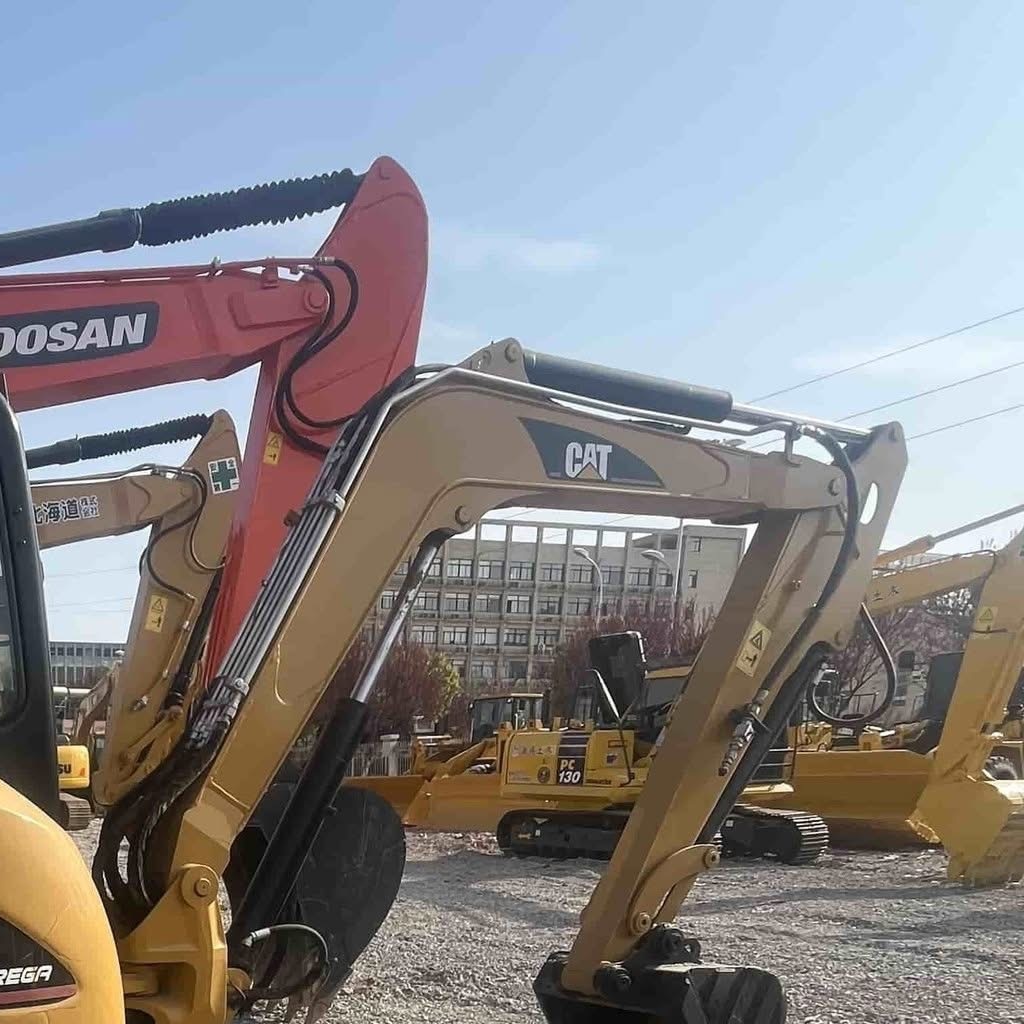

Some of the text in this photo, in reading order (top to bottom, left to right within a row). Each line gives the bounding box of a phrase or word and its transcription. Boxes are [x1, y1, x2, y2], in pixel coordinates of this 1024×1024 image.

[565, 442, 612, 481] CAT
[560, 759, 575, 771] PC
[558, 771, 581, 784] 130
